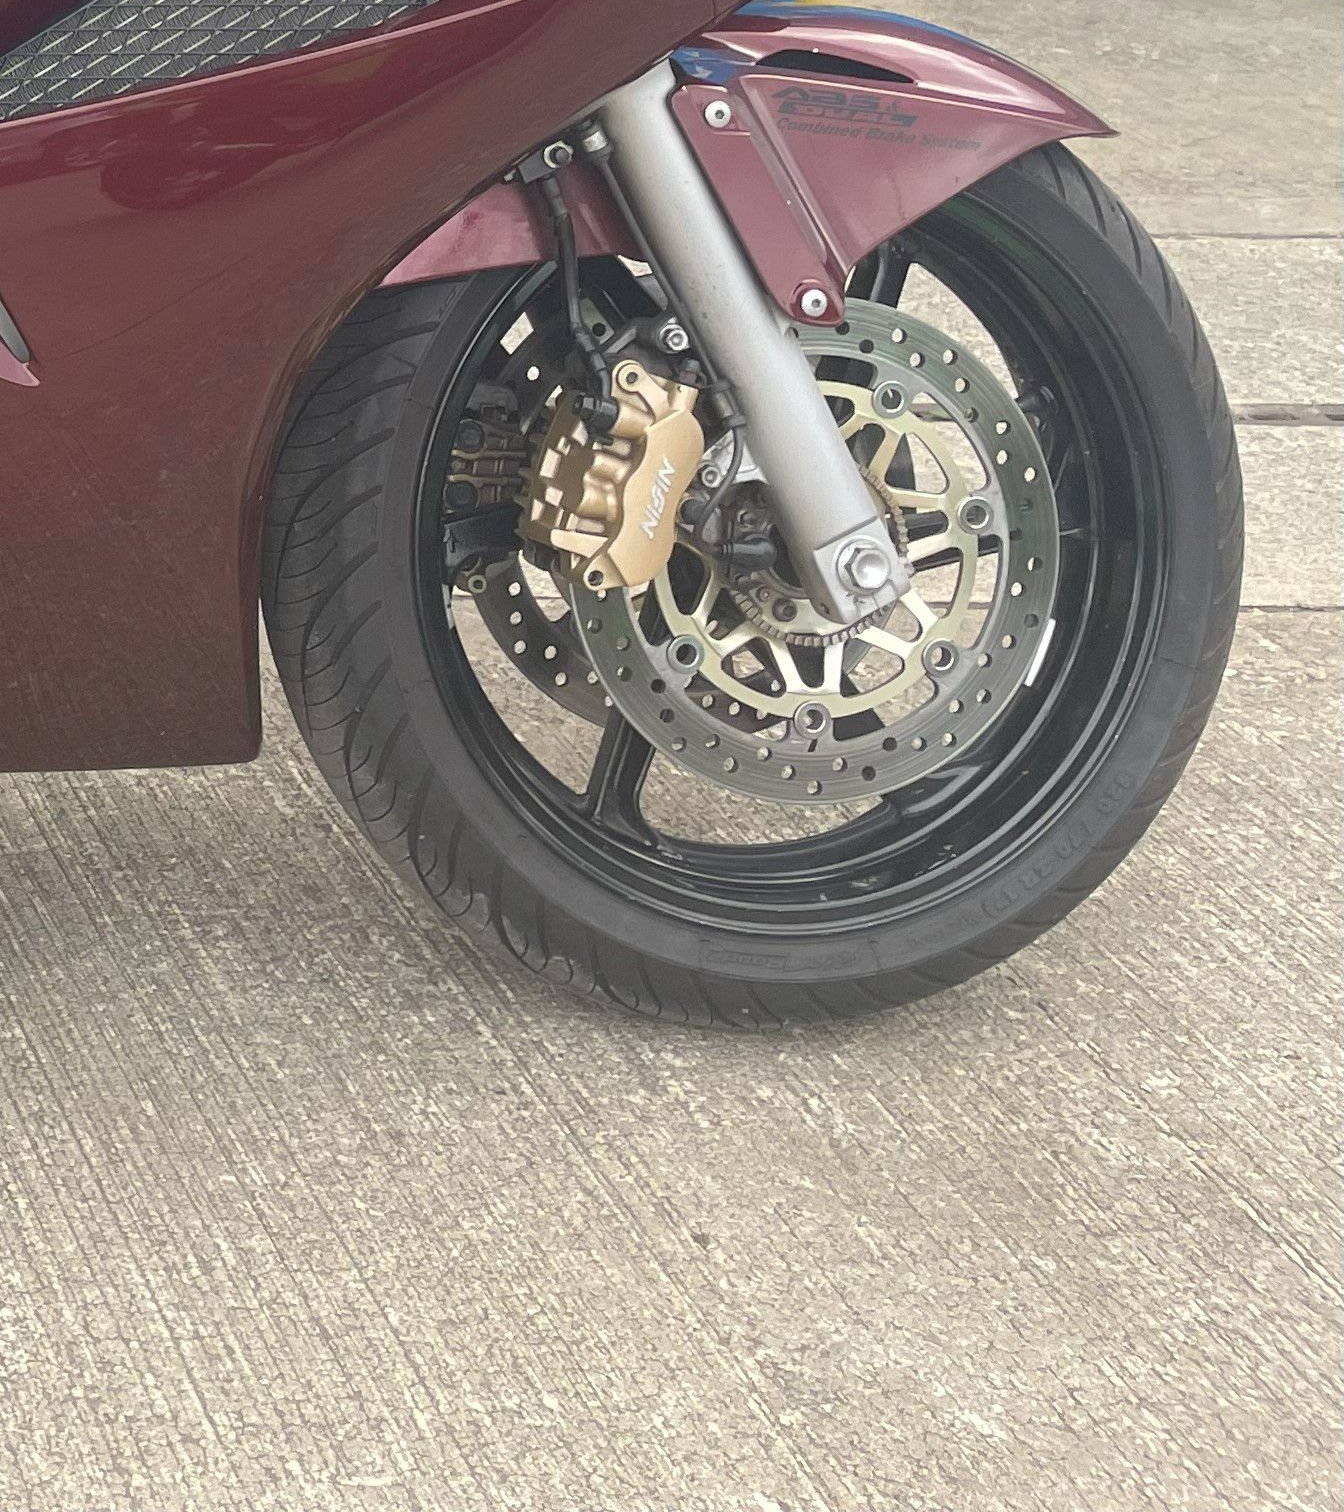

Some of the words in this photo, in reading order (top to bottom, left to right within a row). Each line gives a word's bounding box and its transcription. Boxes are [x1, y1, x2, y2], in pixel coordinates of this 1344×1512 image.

[772, 86, 880, 110] ABS
[786, 101, 914, 127] DUAL
[775, 117, 862, 139] Combined
[865, 127, 917, 144] Brake
[922, 132, 982, 153] System
